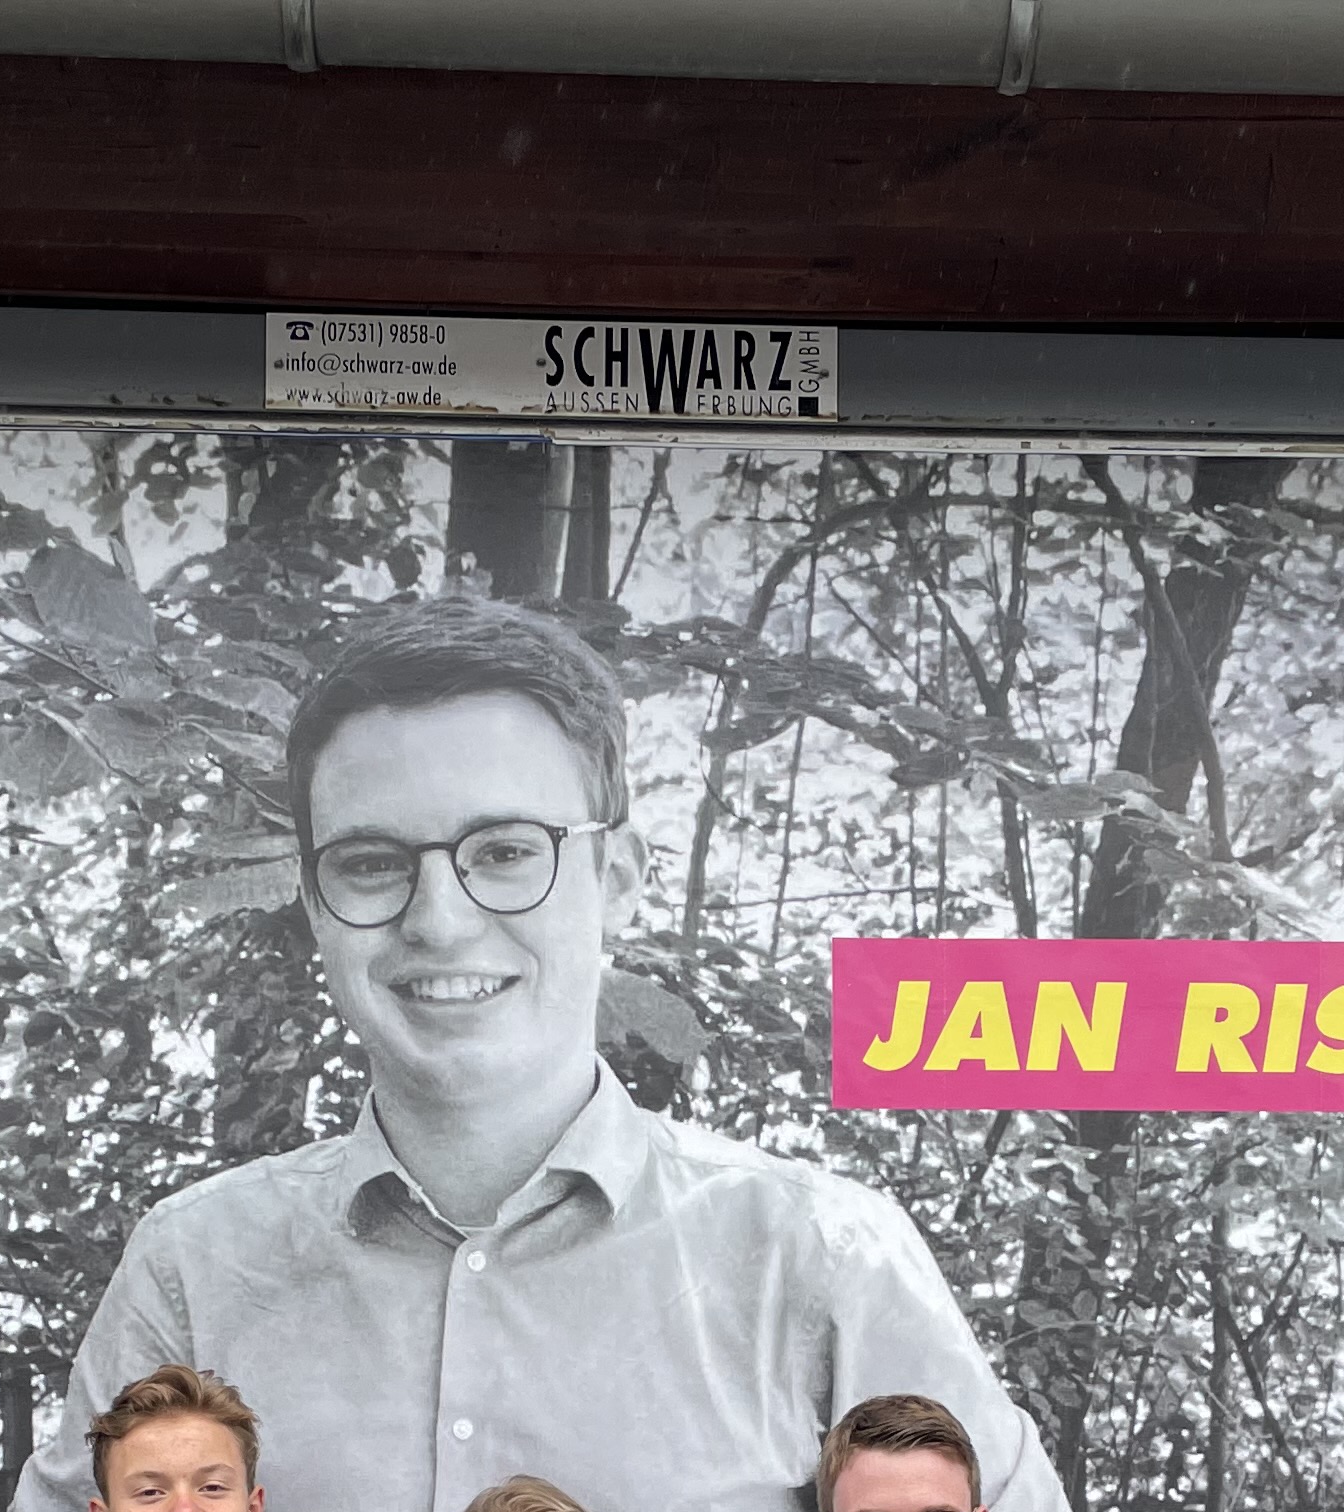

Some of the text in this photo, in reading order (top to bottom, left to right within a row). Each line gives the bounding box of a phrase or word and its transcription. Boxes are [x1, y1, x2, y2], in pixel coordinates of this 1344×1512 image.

[321, 321, 446, 347] (07531) 9858-0
[285, 353, 457, 377] info@schwarz-aw.de
[545, 325, 793, 414] SCHWARZ
[286, 382, 442, 407] www.schwarz-aw.de
[862, 980, 1128, 1073] JAN
